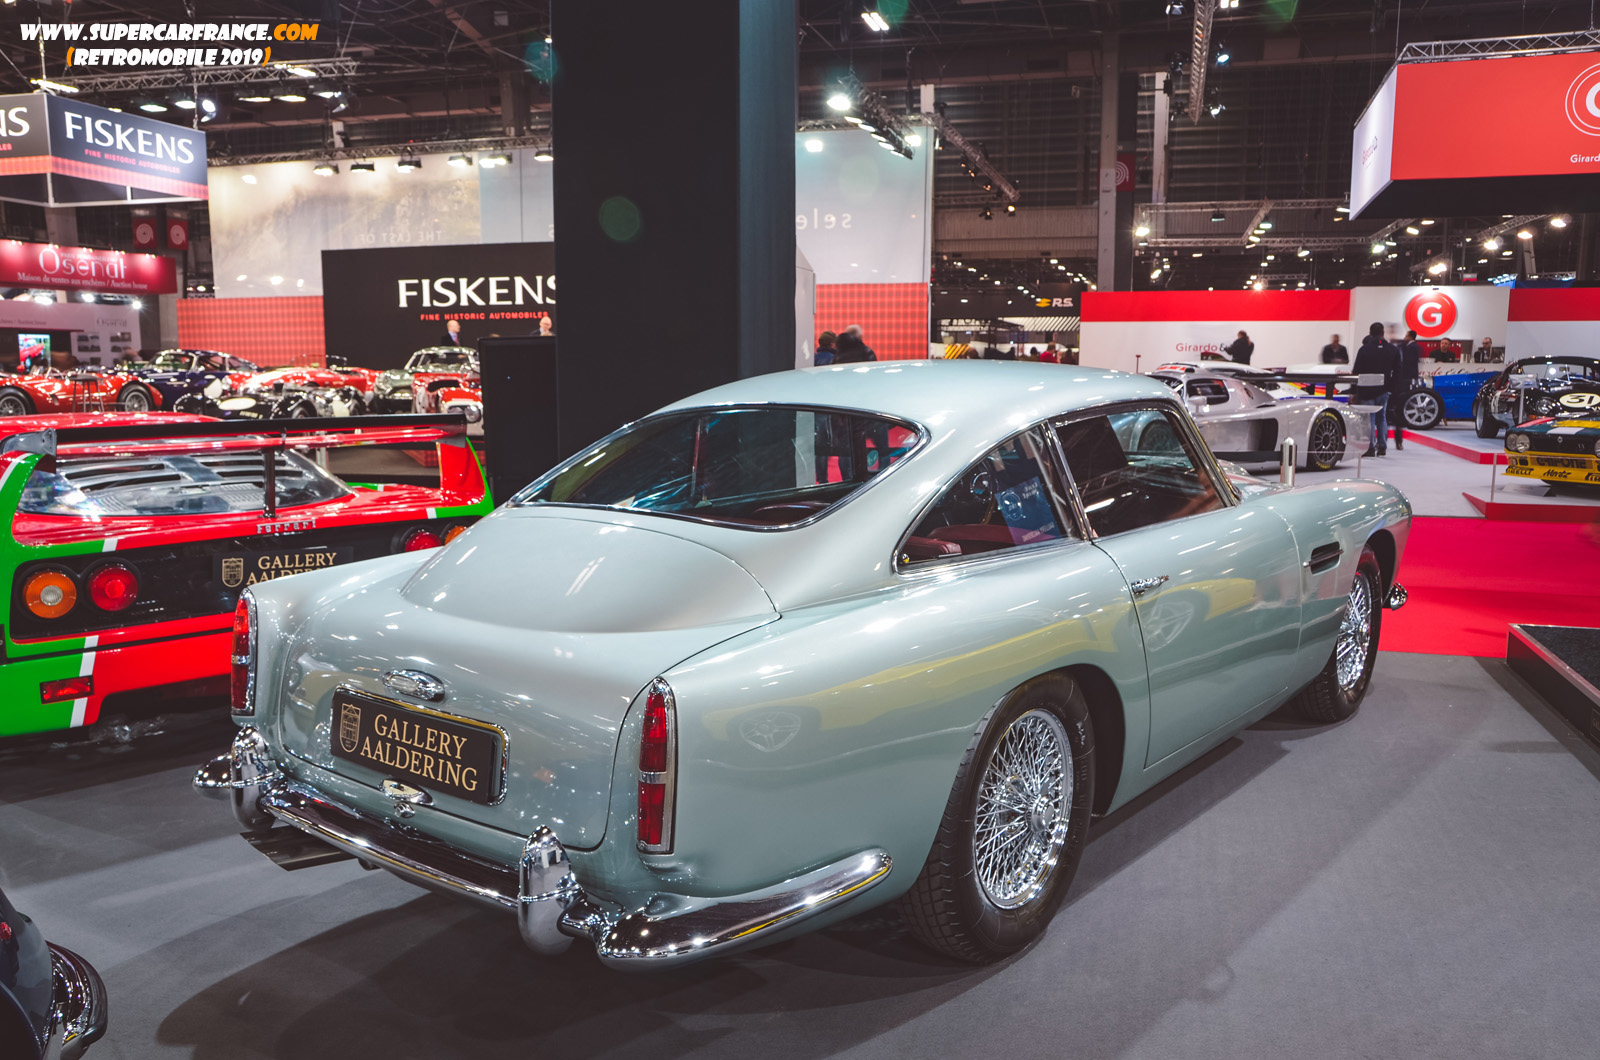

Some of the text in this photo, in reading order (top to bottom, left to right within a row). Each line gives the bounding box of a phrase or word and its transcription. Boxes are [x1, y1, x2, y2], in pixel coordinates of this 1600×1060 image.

[64, 111, 195, 164] FISKENS
[84, 149, 181, 174] FINE HISTORIC AUTOMOBILES
[39, 248, 127, 279] Osenat
[17, 272, 41, 282] Maison
[42, 274, 50, 283] de
[111, 279, 131, 288] Auction
[132, 280, 147, 289] house
[489, 311, 549, 319] AUTOMOBILES
[1417, 302, 1442, 327] G
[1175, 343, 1218, 352] Girardo
[257, 552, 337, 570] GALLERY
[374, 713, 467, 760] GALLERY
[360, 736, 478, 792] AALDERING
